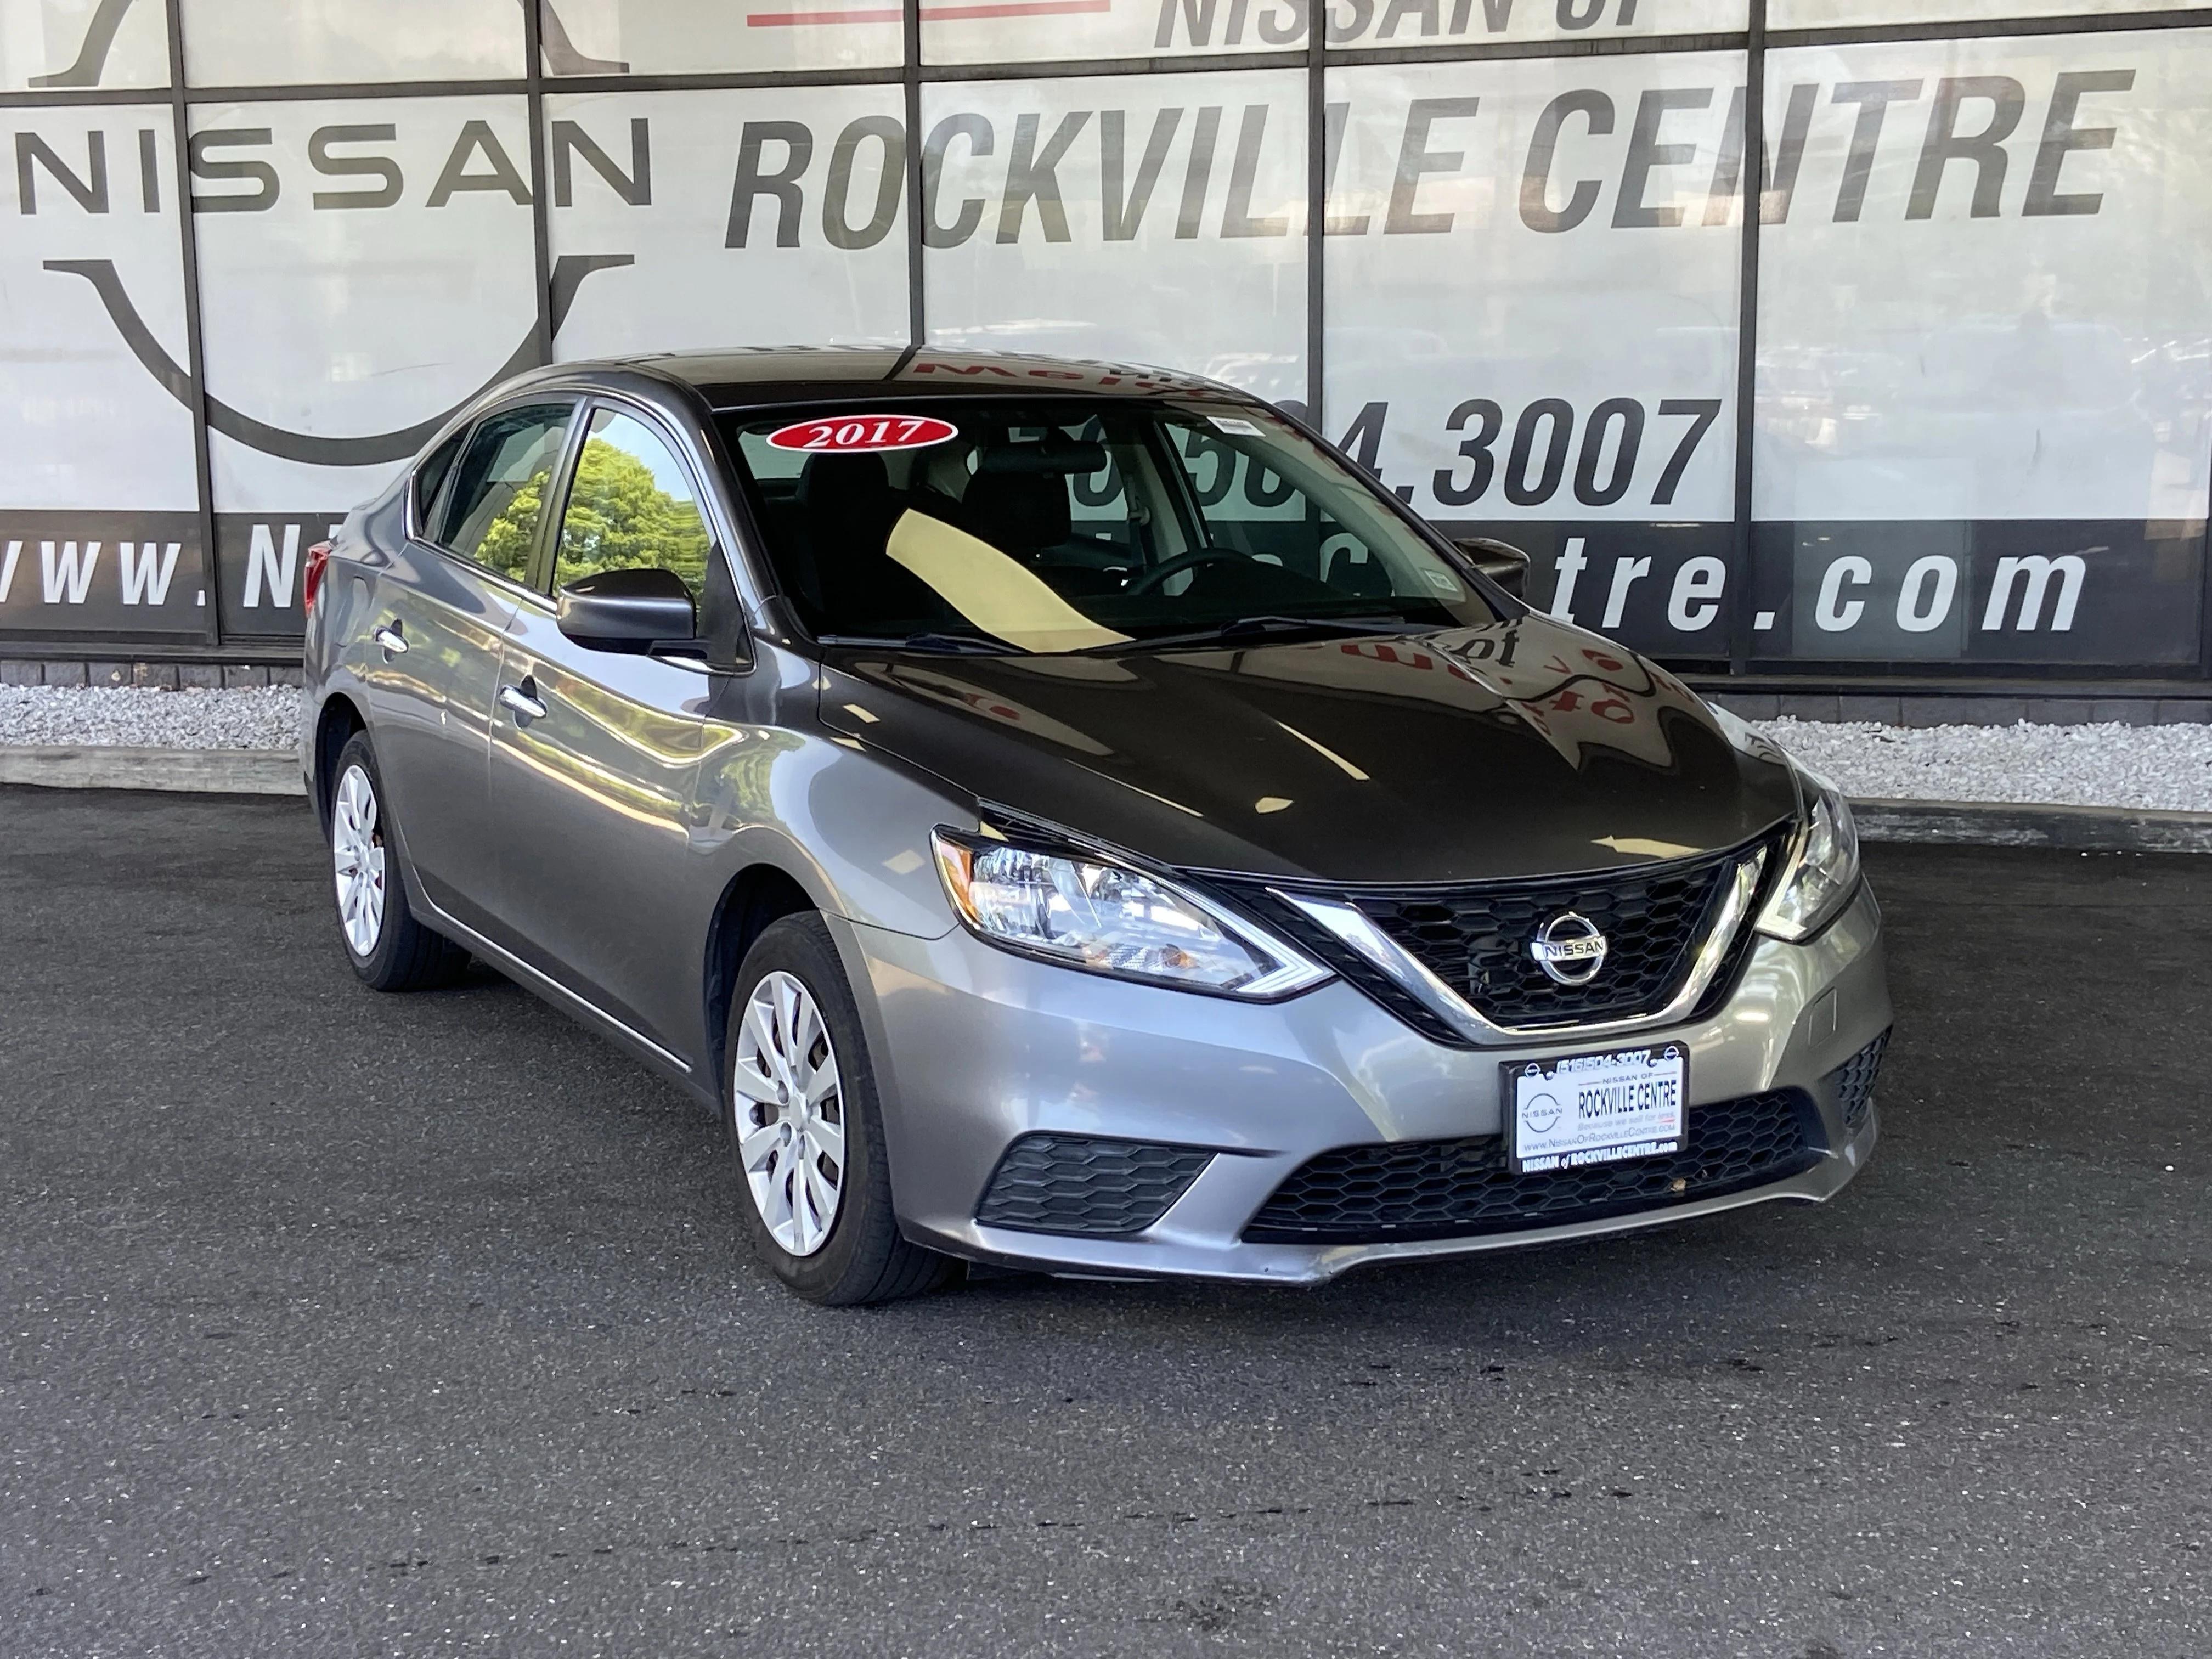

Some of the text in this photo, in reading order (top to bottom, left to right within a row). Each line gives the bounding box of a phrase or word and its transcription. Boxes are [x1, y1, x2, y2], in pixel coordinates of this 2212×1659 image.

[14, 118, 651, 214] NISSAN
[725, 69, 2135, 250] ROCKVILLE CENTRE
[802, 420, 925, 448] 2017
[1545, 940, 1604, 957] NISSAN
[1602, 1074, 1638, 1085] NISSAN
[1578, 1079, 1677, 1119] ROCKVILLE CENTRE
[1521, 1108, 1562, 1119] NISSAN
[1522, 1155, 1560, 1173] NISSAN
